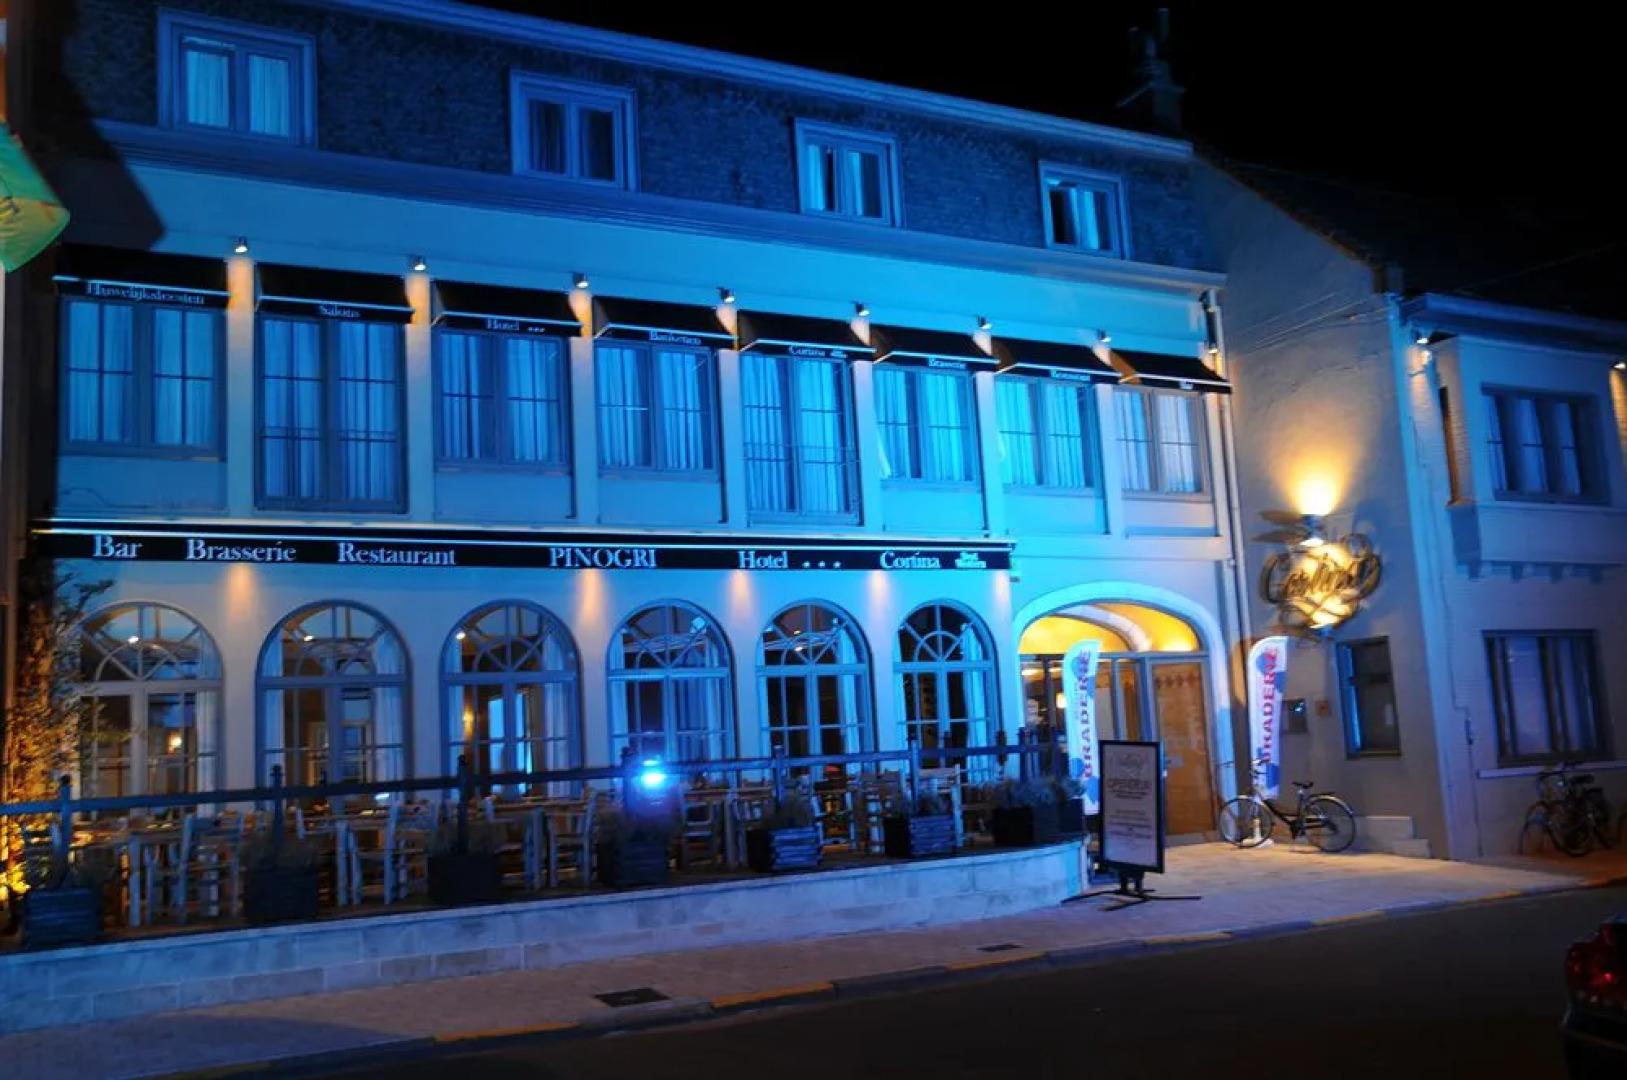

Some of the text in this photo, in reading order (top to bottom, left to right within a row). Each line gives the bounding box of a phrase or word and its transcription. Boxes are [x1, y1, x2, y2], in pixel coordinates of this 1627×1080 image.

[93, 534, 942, 570] Bar Brasserie Restaurant PINOGRI Hotel Cortina
[1262, 646, 1278, 763] BRADERIE
